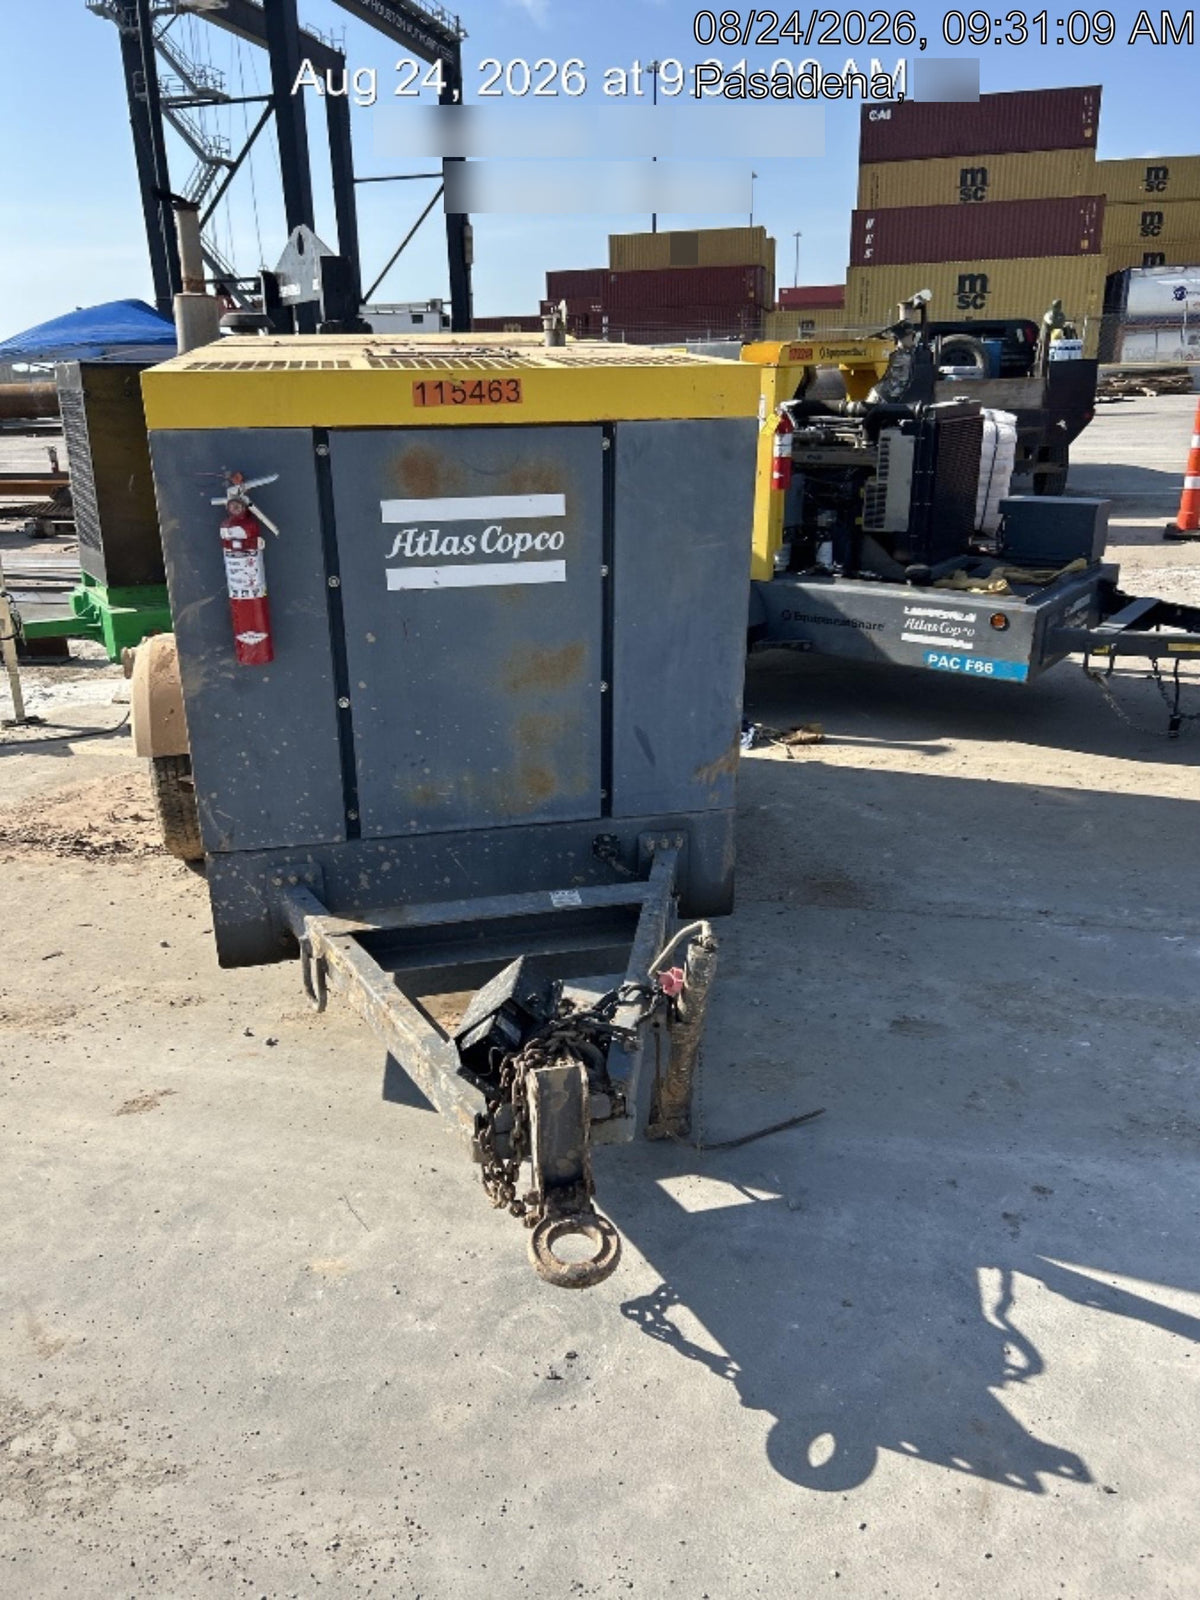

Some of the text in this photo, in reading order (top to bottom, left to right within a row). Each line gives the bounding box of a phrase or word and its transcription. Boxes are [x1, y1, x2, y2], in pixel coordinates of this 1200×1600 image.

[868, 108, 892, 121] CAI
[415, 379, 521, 406] 115463
[384, 525, 565, 559] Atlas Copco
[904, 618, 938, 632] Atlas
[928, 653, 961, 669] PAC
